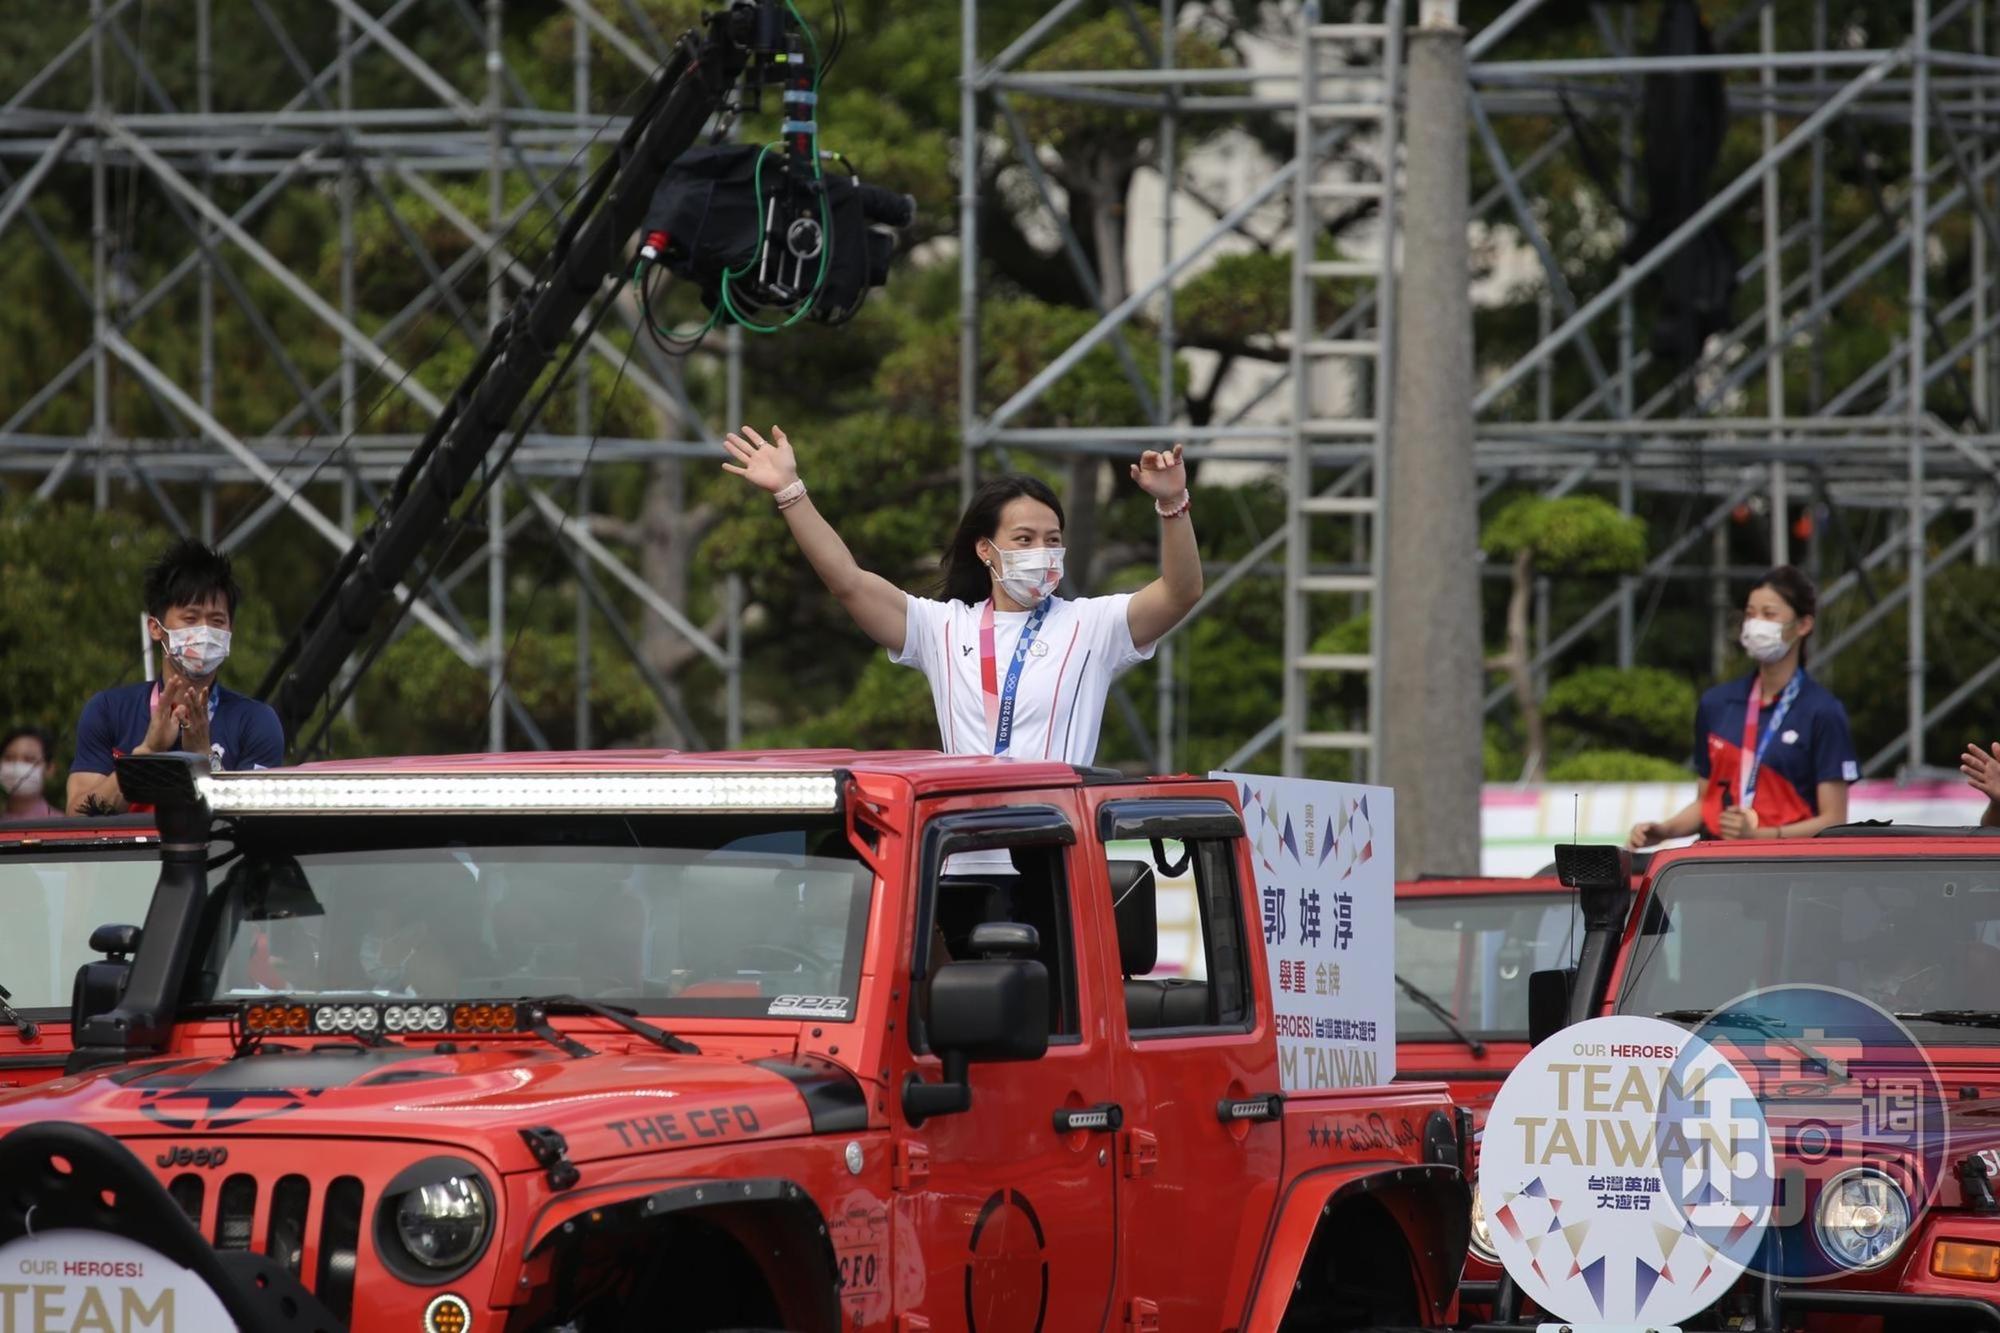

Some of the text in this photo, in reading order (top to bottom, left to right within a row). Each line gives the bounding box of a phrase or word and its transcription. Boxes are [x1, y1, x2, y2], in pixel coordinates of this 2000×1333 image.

[1000, 695, 1013, 742] TOKYO 2020
[1280, 959, 1307, 994] 舉重
[1304, 1047, 1377, 1089] TAIWAN
[1573, 1043, 1679, 1059] OUR HEROES!
[1547, 1064, 1705, 1115] TEAM
[606, 1105, 760, 1148] THE CFO
[1514, 1117, 1738, 1171] TAIWAN
[156, 1144, 228, 1168] Jeep
[1588, 1175, 1661, 1193] 台灣英雄
[1597, 1194, 1650, 1210] 大遊行
[19, 1259, 144, 1278] OUR HEROES!
[0, 1284, 175, 1333] TEAM
